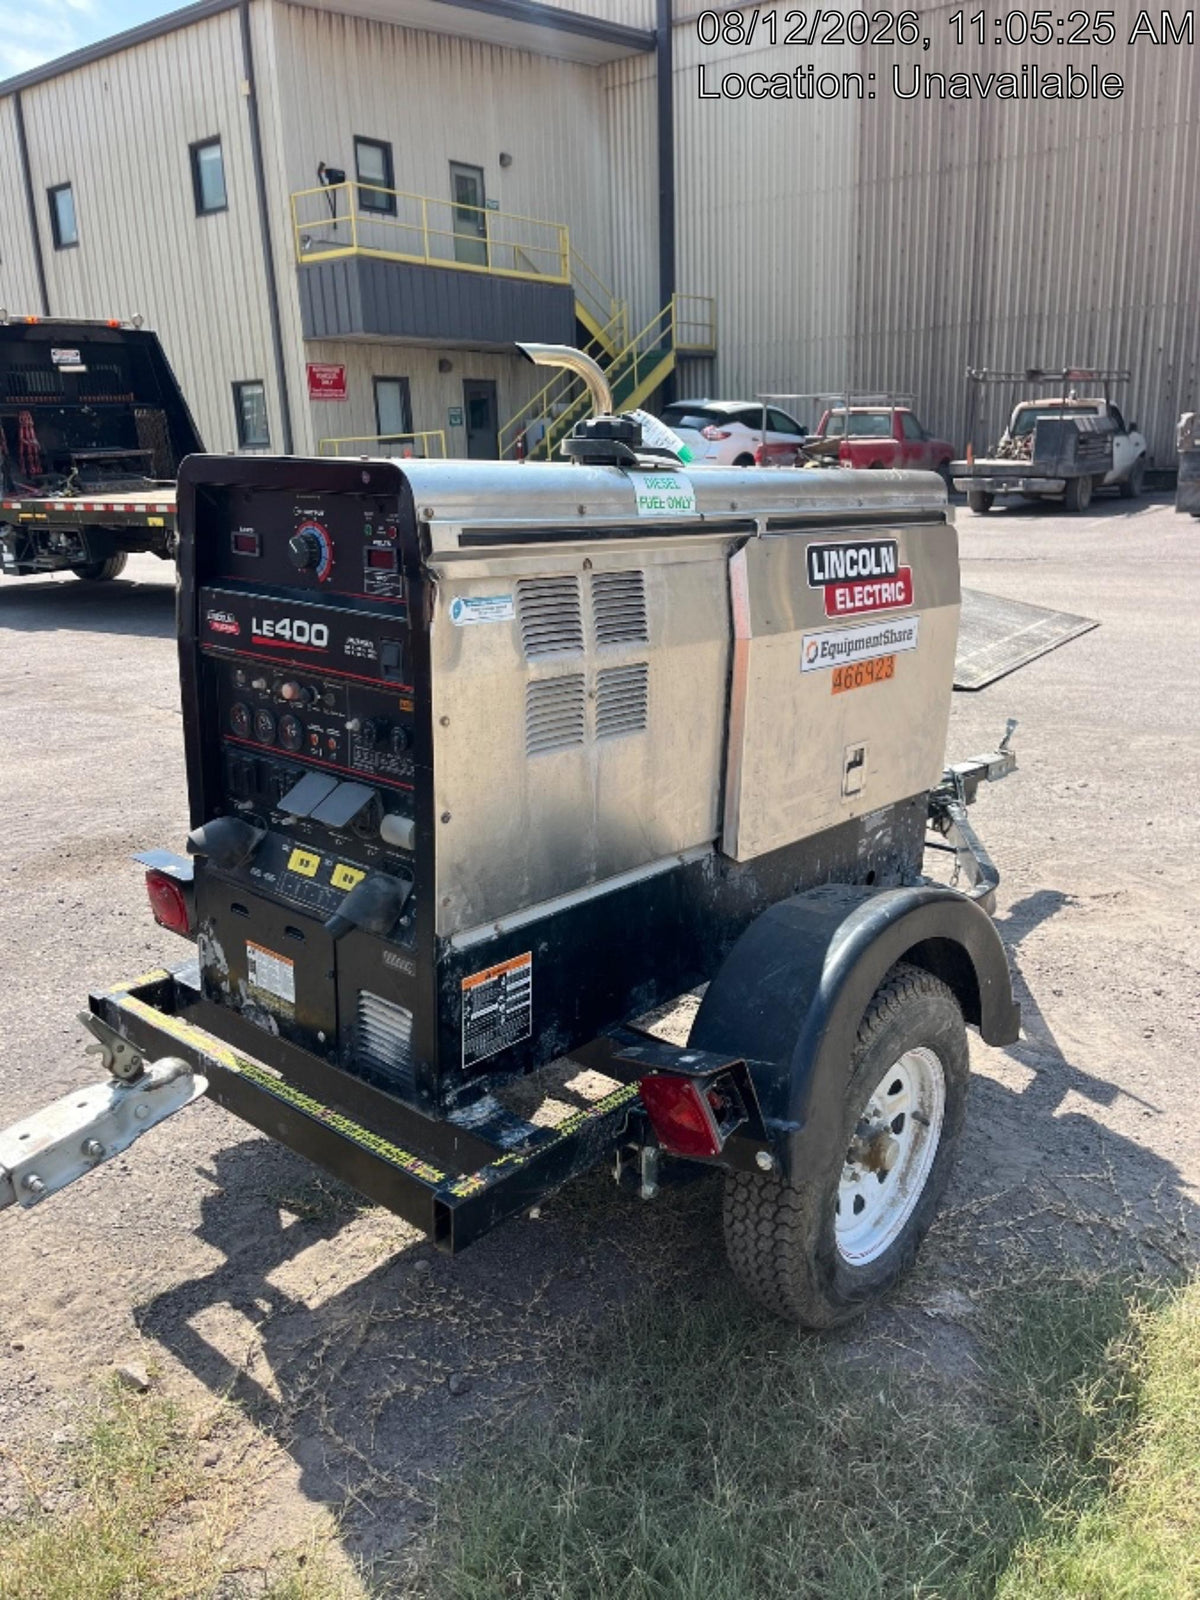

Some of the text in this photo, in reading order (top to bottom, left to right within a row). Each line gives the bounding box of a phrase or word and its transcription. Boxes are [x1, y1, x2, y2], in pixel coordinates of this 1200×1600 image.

[643, 477, 681, 489] DIESEL
[640, 496, 692, 509] FUEL ONLY
[812, 546, 895, 580] LINCOLN
[835, 581, 906, 611] ELECTRIC
[251, 617, 329, 647] LE400
[820, 628, 914, 660] EquipmentShare
[832, 656, 895, 689] 466923
